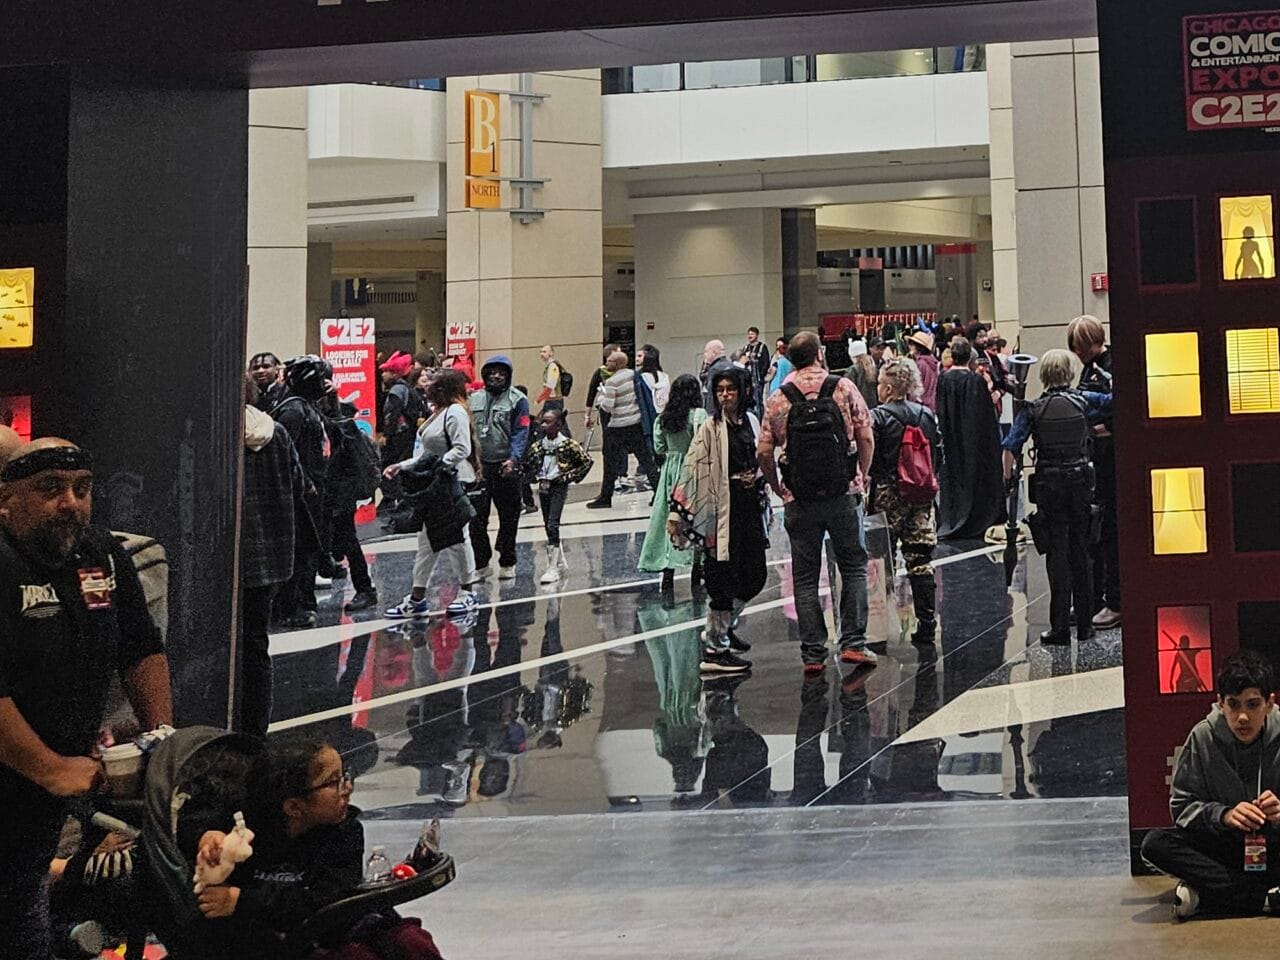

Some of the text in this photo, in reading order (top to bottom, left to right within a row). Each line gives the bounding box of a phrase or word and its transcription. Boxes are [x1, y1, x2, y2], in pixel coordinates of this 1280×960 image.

[1191, 58, 1200, 67] &
[472, 185, 500, 197] NORTH
[321, 318, 376, 345] C2E2
[447, 322, 477, 339] C2E2
